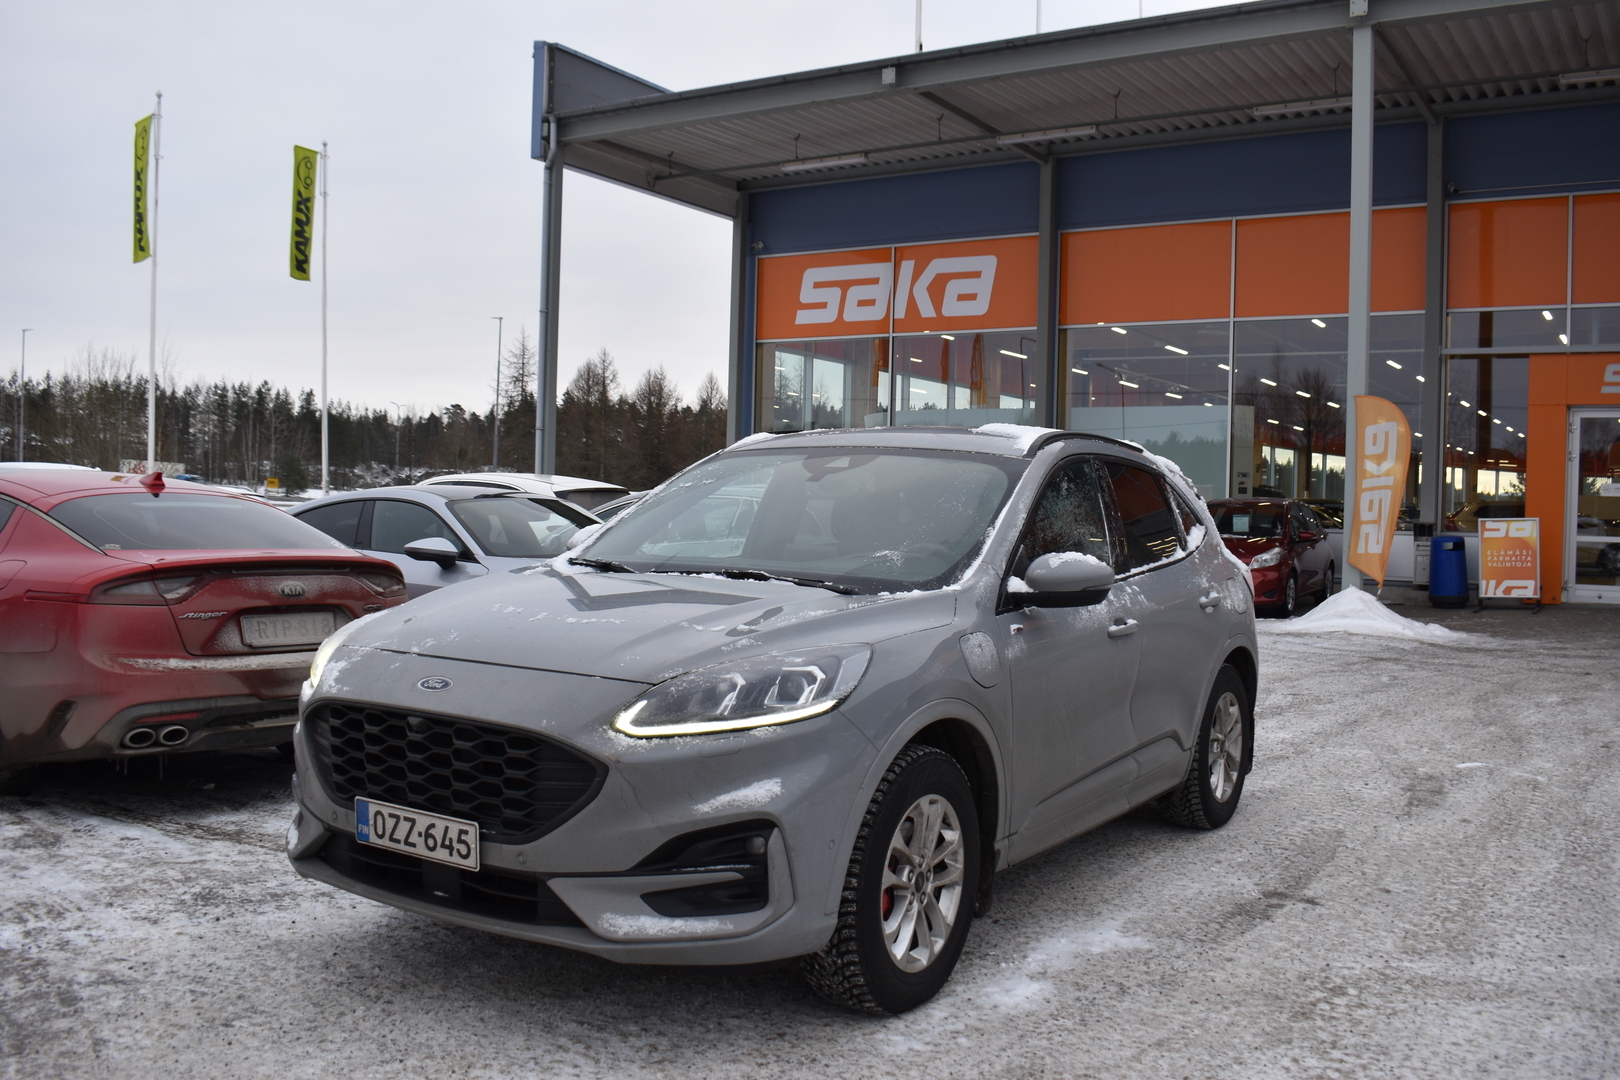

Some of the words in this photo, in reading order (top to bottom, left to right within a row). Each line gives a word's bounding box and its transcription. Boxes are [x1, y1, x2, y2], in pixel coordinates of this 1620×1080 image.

[294, 188, 312, 274] KAMUX
[283, 587, 303, 595] KIA
[424, 679, 446, 688] Ford
[358, 824, 369, 835] FIN
[373, 810, 472, 860] OZZ-645
